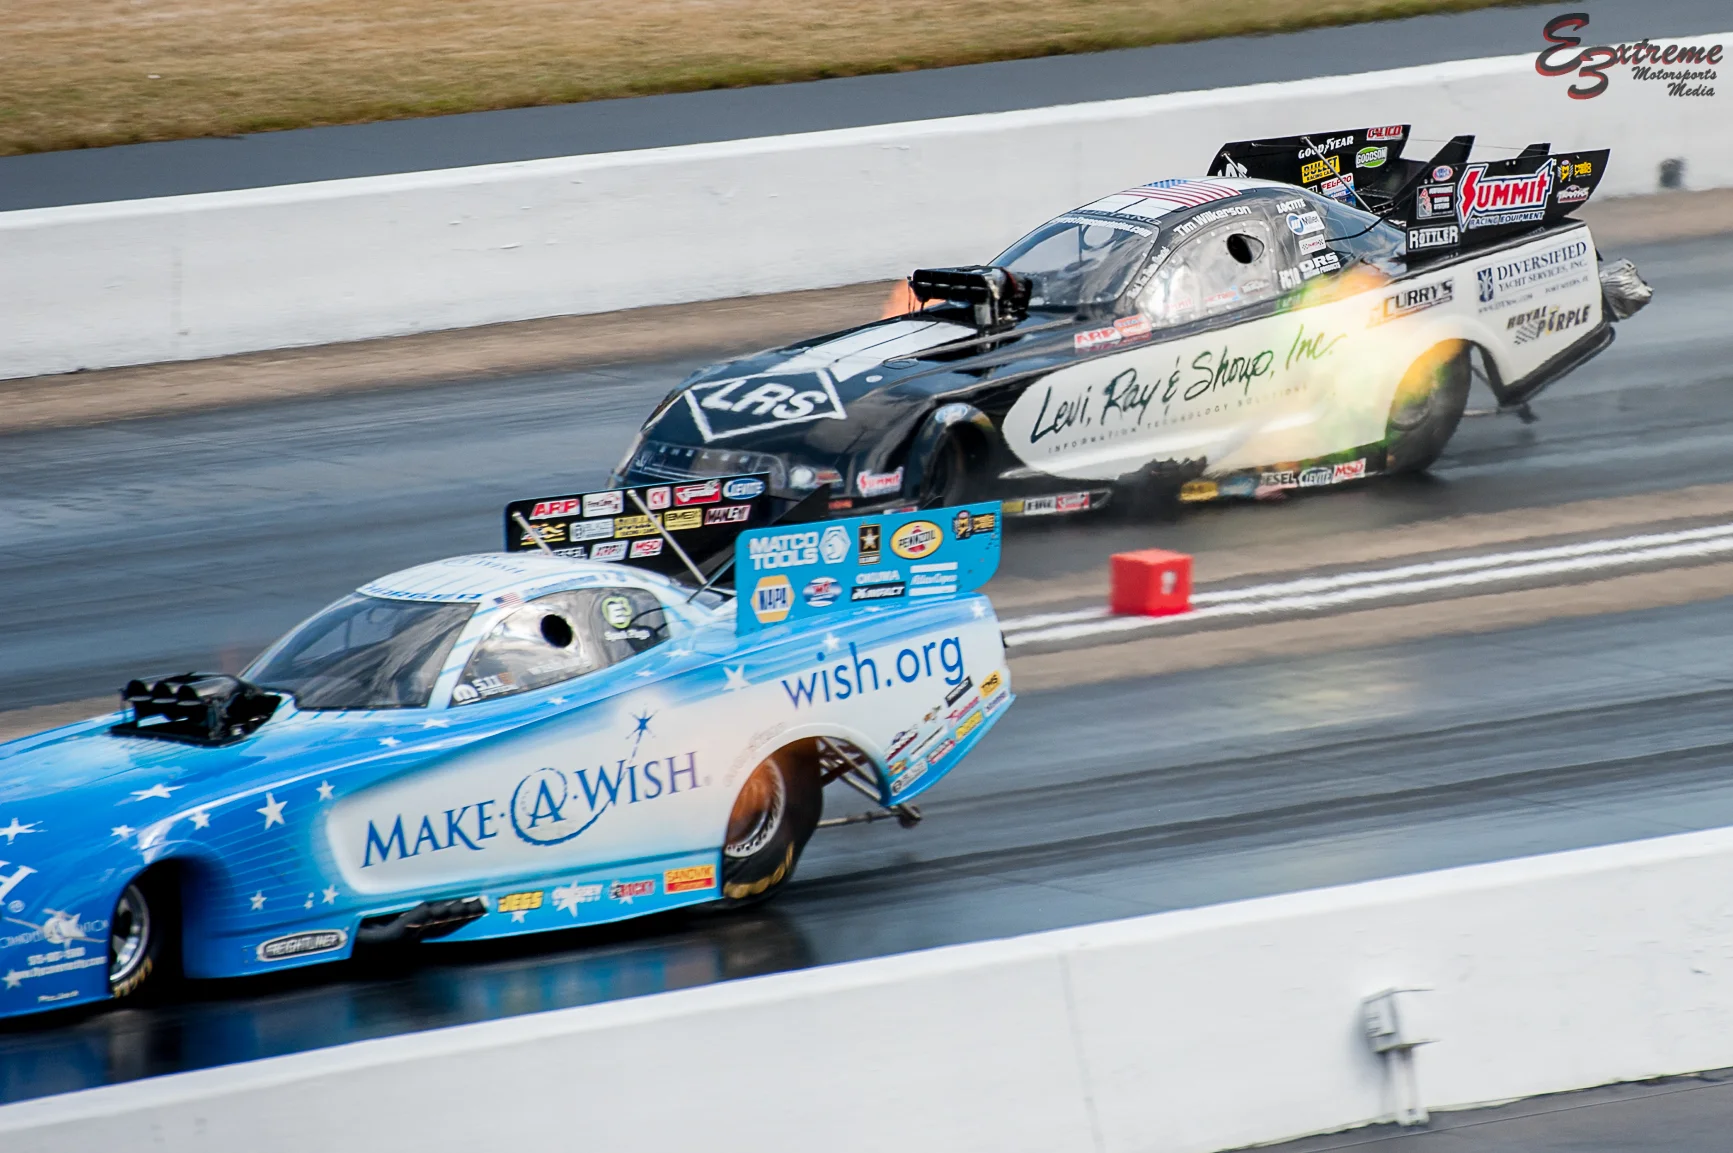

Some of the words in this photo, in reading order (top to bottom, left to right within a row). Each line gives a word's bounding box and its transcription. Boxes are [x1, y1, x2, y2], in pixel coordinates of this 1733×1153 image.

[1367, 125, 1402, 138] CALICO
[1356, 147, 1387, 166] GOODSON
[1276, 198, 1306, 213] LOCTITE
[1173, 219, 1196, 237] Tim
[1194, 205, 1252, 230] Wilkerson
[1470, 215, 1499, 227] RACING
[1500, 211, 1544, 223] EQUIPMENT
[1409, 226, 1459, 249] ROTTLER
[1497, 241, 1587, 281] DIVERSIFIED
[1499, 277, 1526, 292] YACHT
[1506, 305, 1547, 330] ROYAL
[1077, 328, 1115, 345] ARP
[701, 379, 829, 419] LRS
[1031, 386, 1092, 444] Levi,
[1101, 367, 1161, 425] Ray
[1048, 426, 1137, 454] INFORMATION
[1147, 404, 1229, 429] TECHNOLOGY
[1335, 462, 1364, 477] MSD
[533, 499, 580, 517] ARP
[750, 532, 818, 554] MATCO
[898, 530, 935, 549] PENNZOIL
[750, 550, 818, 570] TOOLS
[758, 586, 789, 611] NAPA
[782, 637, 965, 709] wish.org
